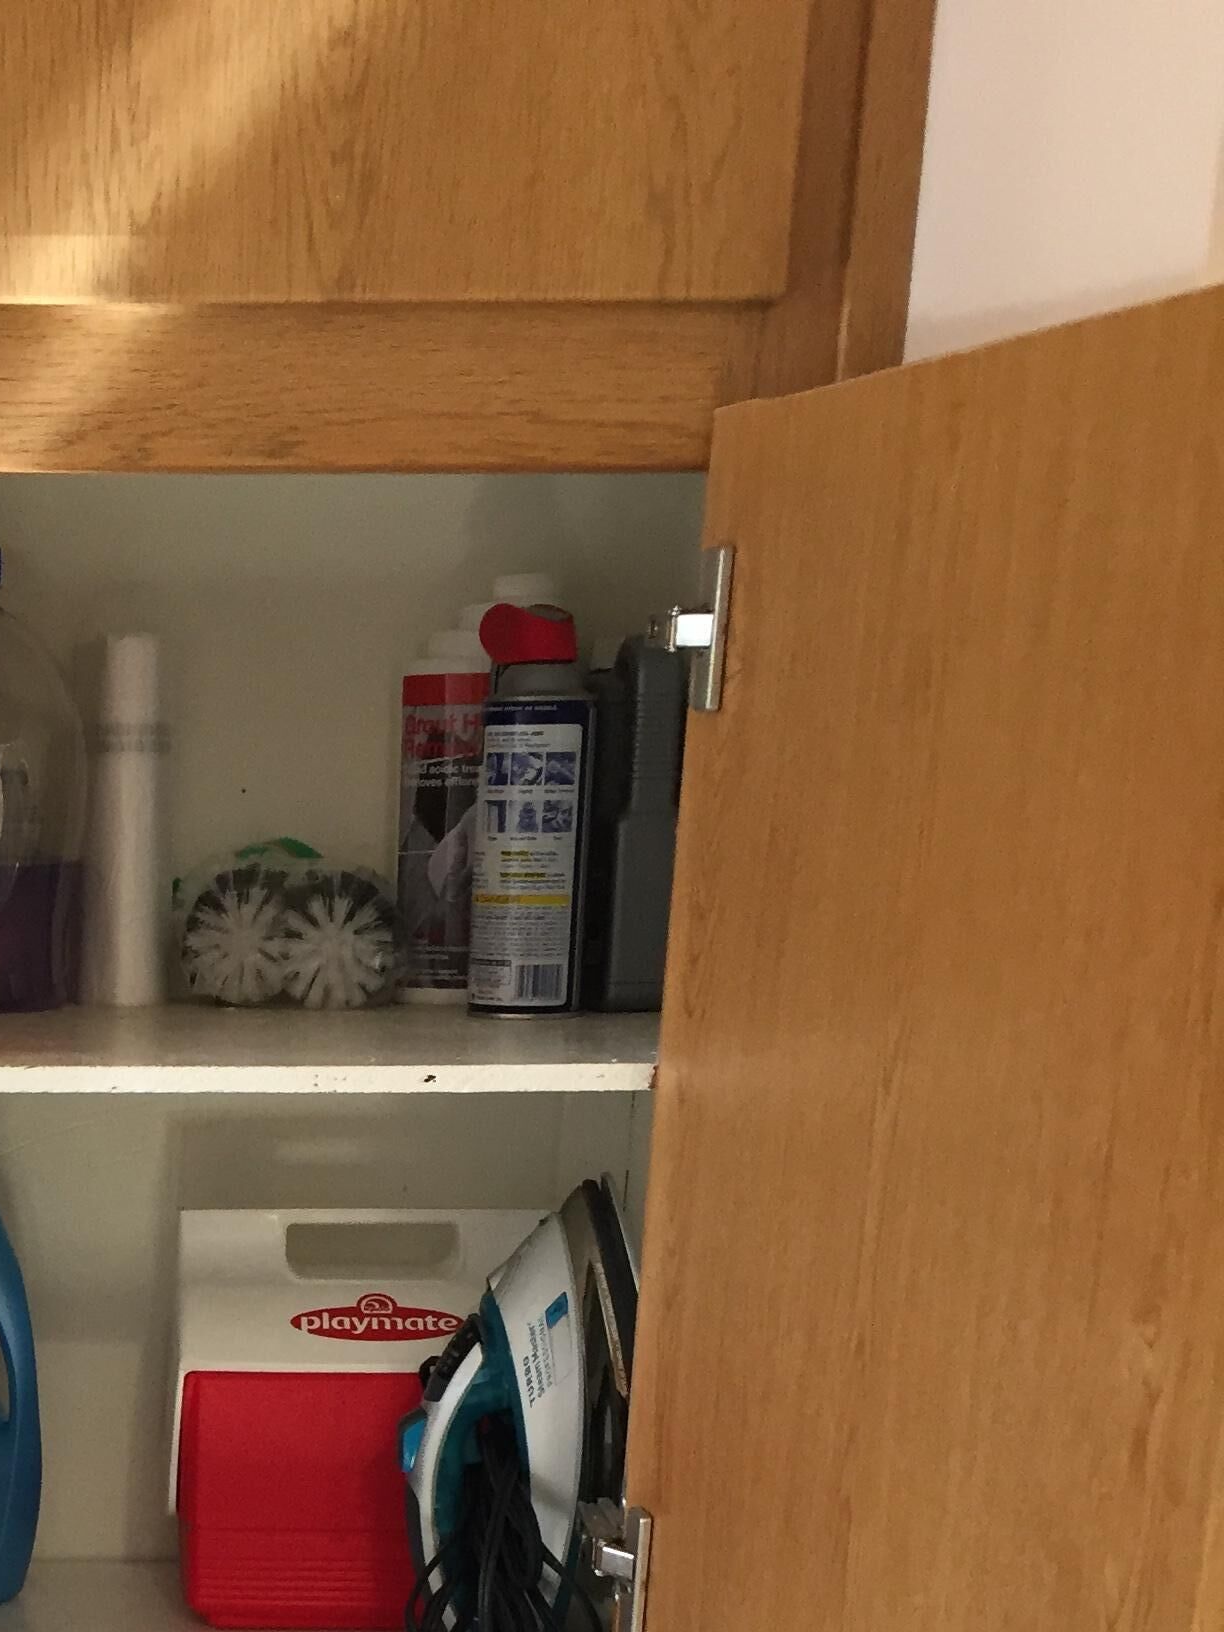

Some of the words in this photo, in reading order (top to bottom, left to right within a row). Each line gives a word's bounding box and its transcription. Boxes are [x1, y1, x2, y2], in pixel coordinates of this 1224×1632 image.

[300, 1311, 459, 1335] playmate
[523, 1355, 536, 1408] TURBO
[534, 1360, 546, 1398] Steam
